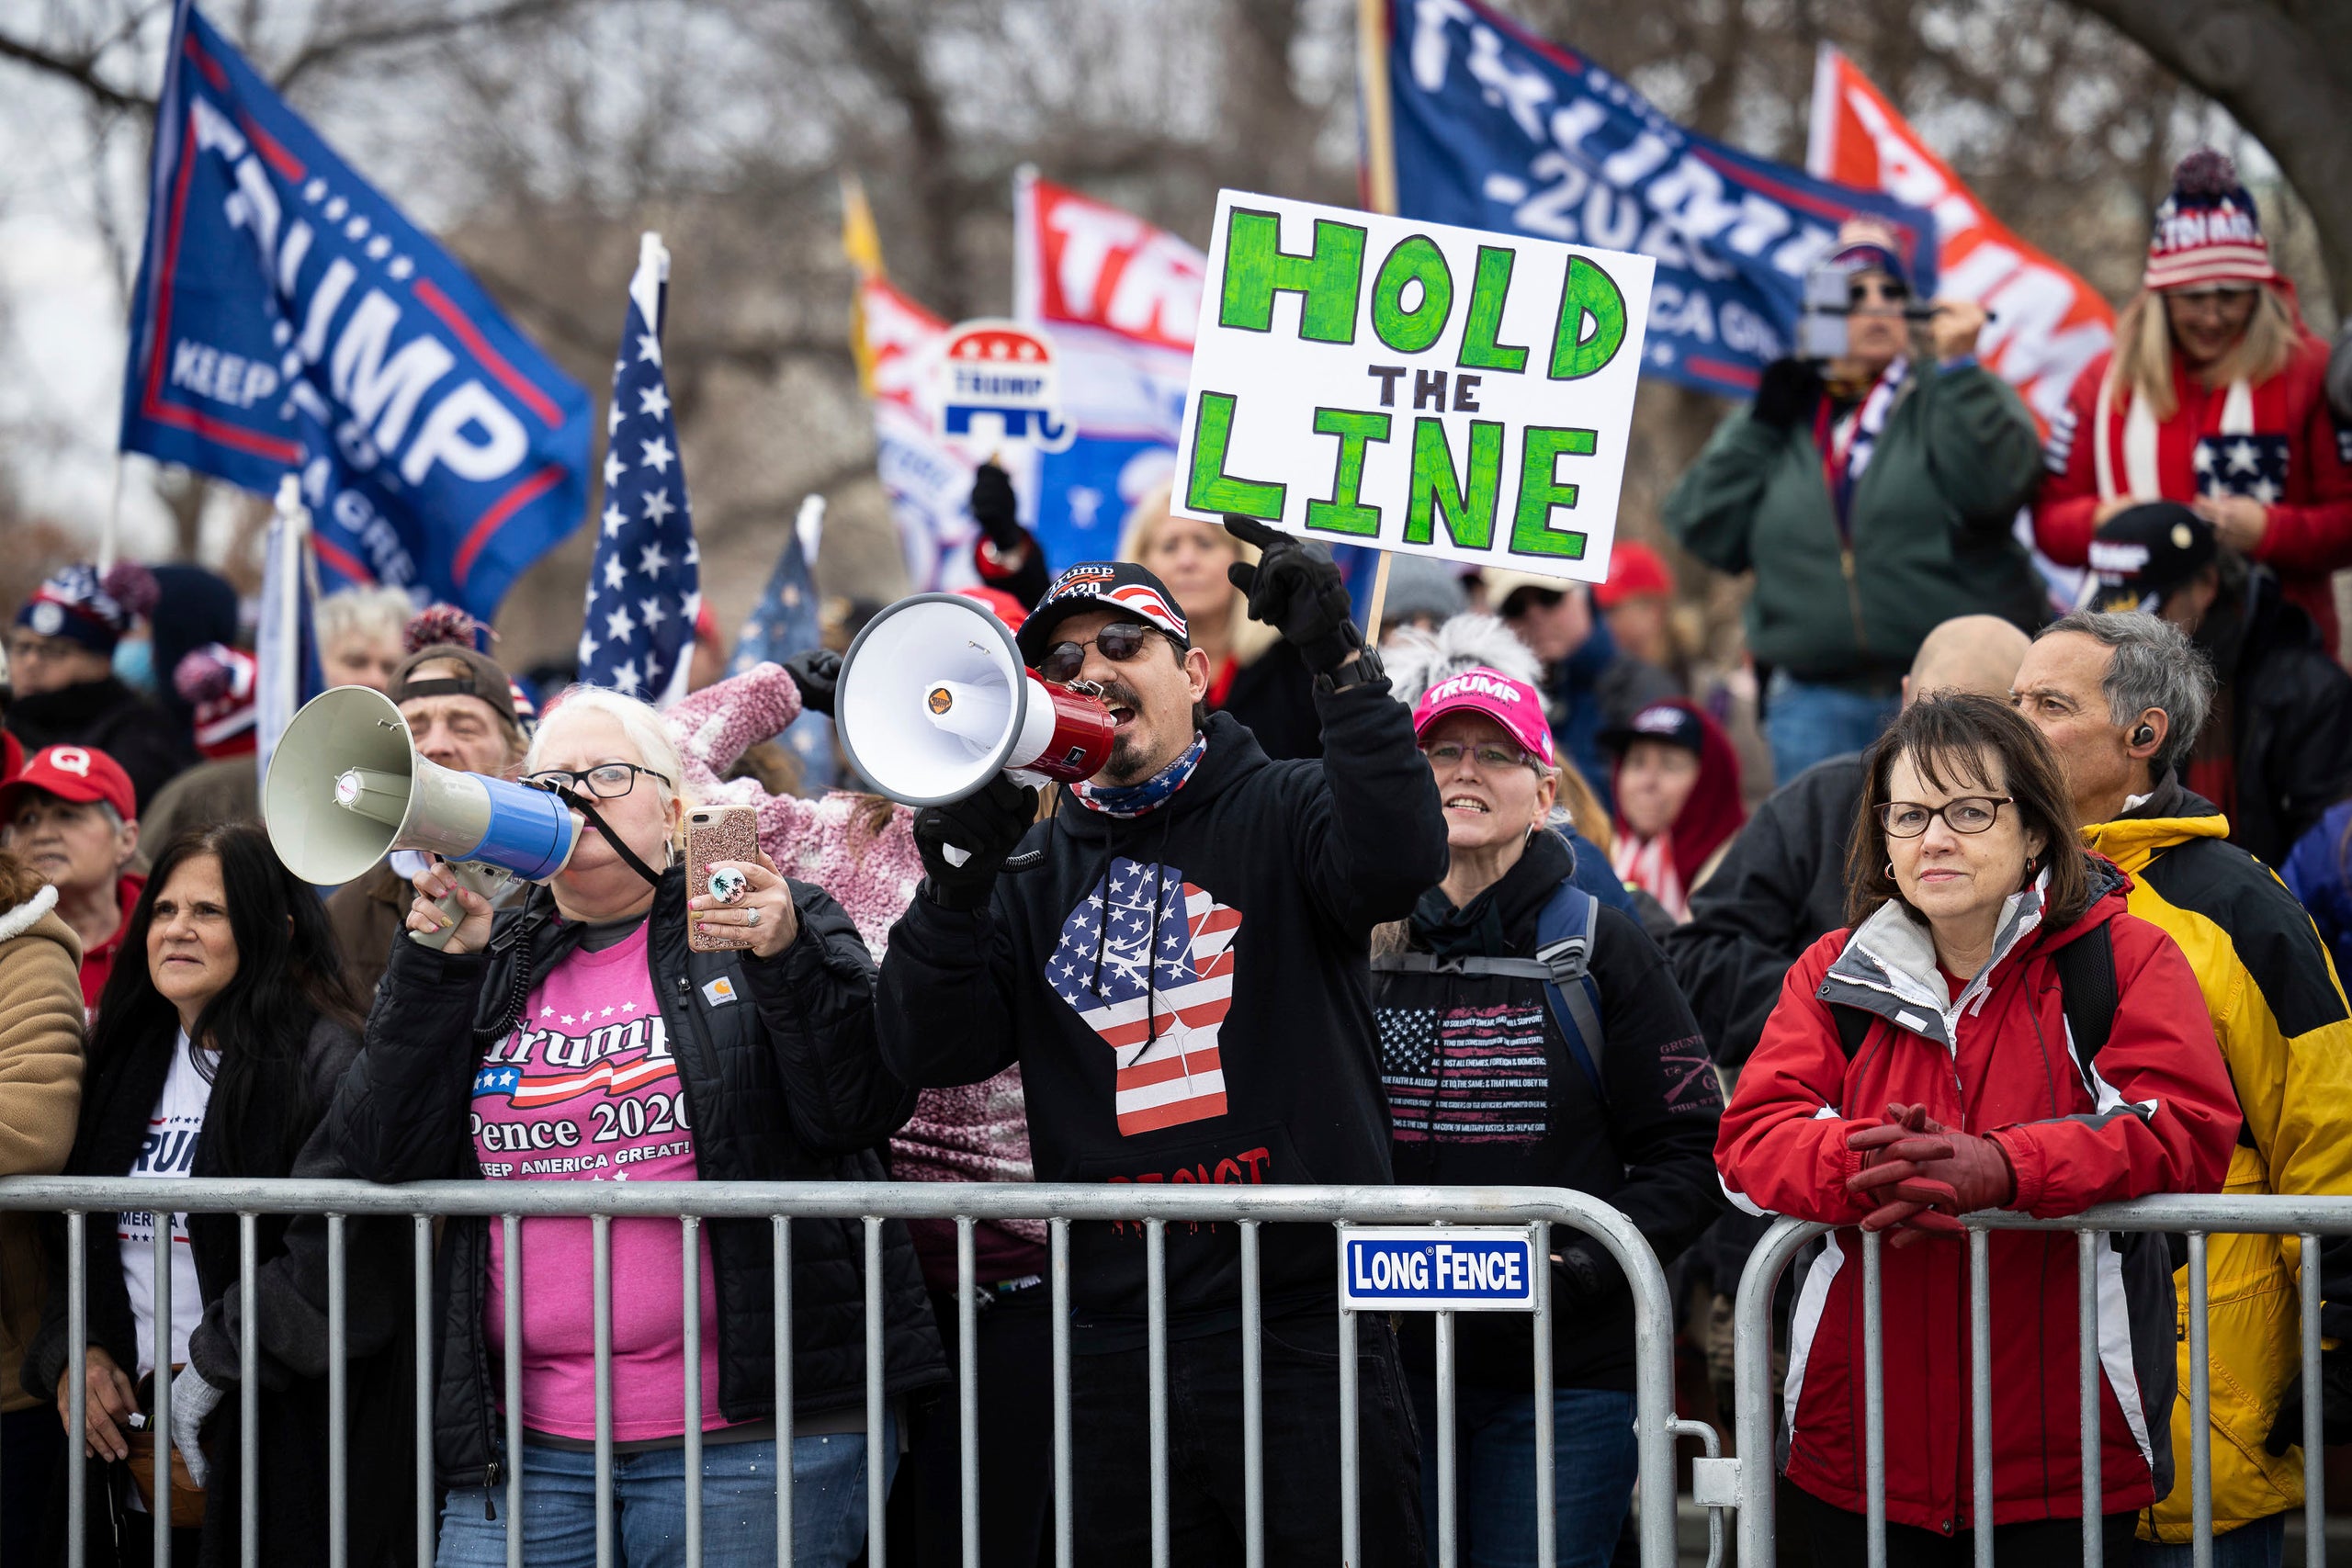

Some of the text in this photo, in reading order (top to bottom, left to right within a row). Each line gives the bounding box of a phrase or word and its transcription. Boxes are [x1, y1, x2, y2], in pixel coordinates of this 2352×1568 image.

[1218, 206, 1629, 382] HOLD
[1367, 364, 1482, 413] THE
[1184, 389, 1599, 560] LINE
[1430, 674, 1521, 705] TRUMP
[50, 746, 91, 778] Q
[1490, 1079, 1506, 1088] THAT
[1509, 1079, 1522, 1088] WILL
[520, 1153, 609, 1175] AMERICA
[614, 1141, 689, 1165] GREAT!
[1435, 1244, 1521, 1291] FENCE
